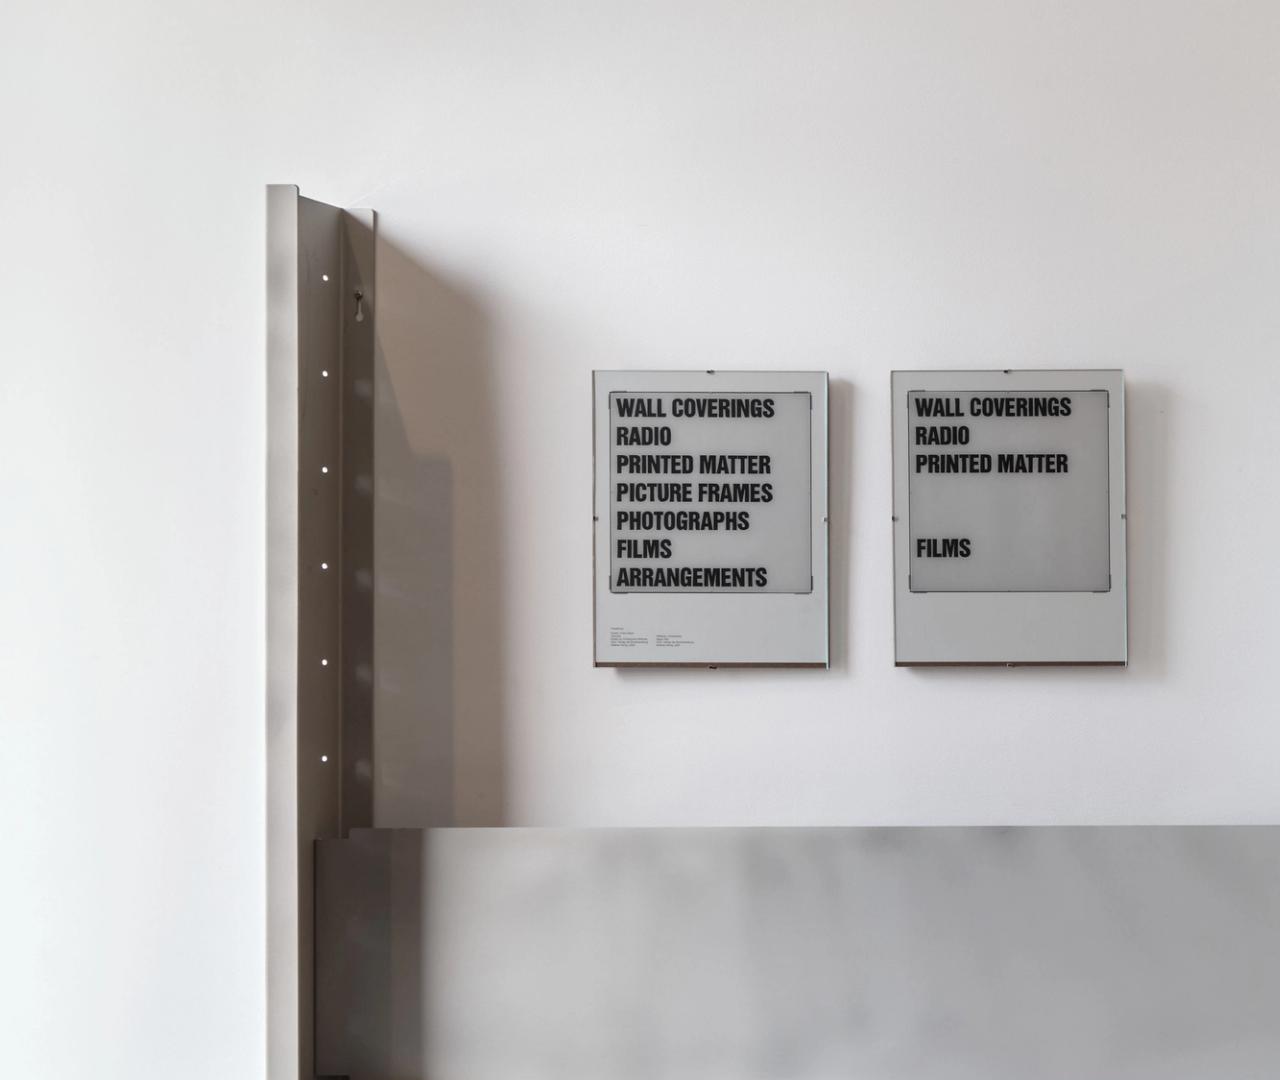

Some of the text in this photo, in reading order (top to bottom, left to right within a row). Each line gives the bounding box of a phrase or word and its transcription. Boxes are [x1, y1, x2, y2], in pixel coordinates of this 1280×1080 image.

[616, 398, 774, 418] WALL COVERINGS
[915, 397, 1071, 417] WALL COVERINGS
[617, 427, 671, 446] RADIO
[916, 426, 969, 445] RADIO
[617, 455, 770, 474] PRINTED MATTER
[916, 454, 1068, 473] PRINTED MATTER
[617, 483, 773, 502] PICTURE FRAMES
[617, 511, 749, 530] PHOTOGRAPHS
[617, 539, 671, 558] FILMS
[917, 539, 971, 557] FILMS
[617, 567, 767, 587] ARRANGEMENTS
